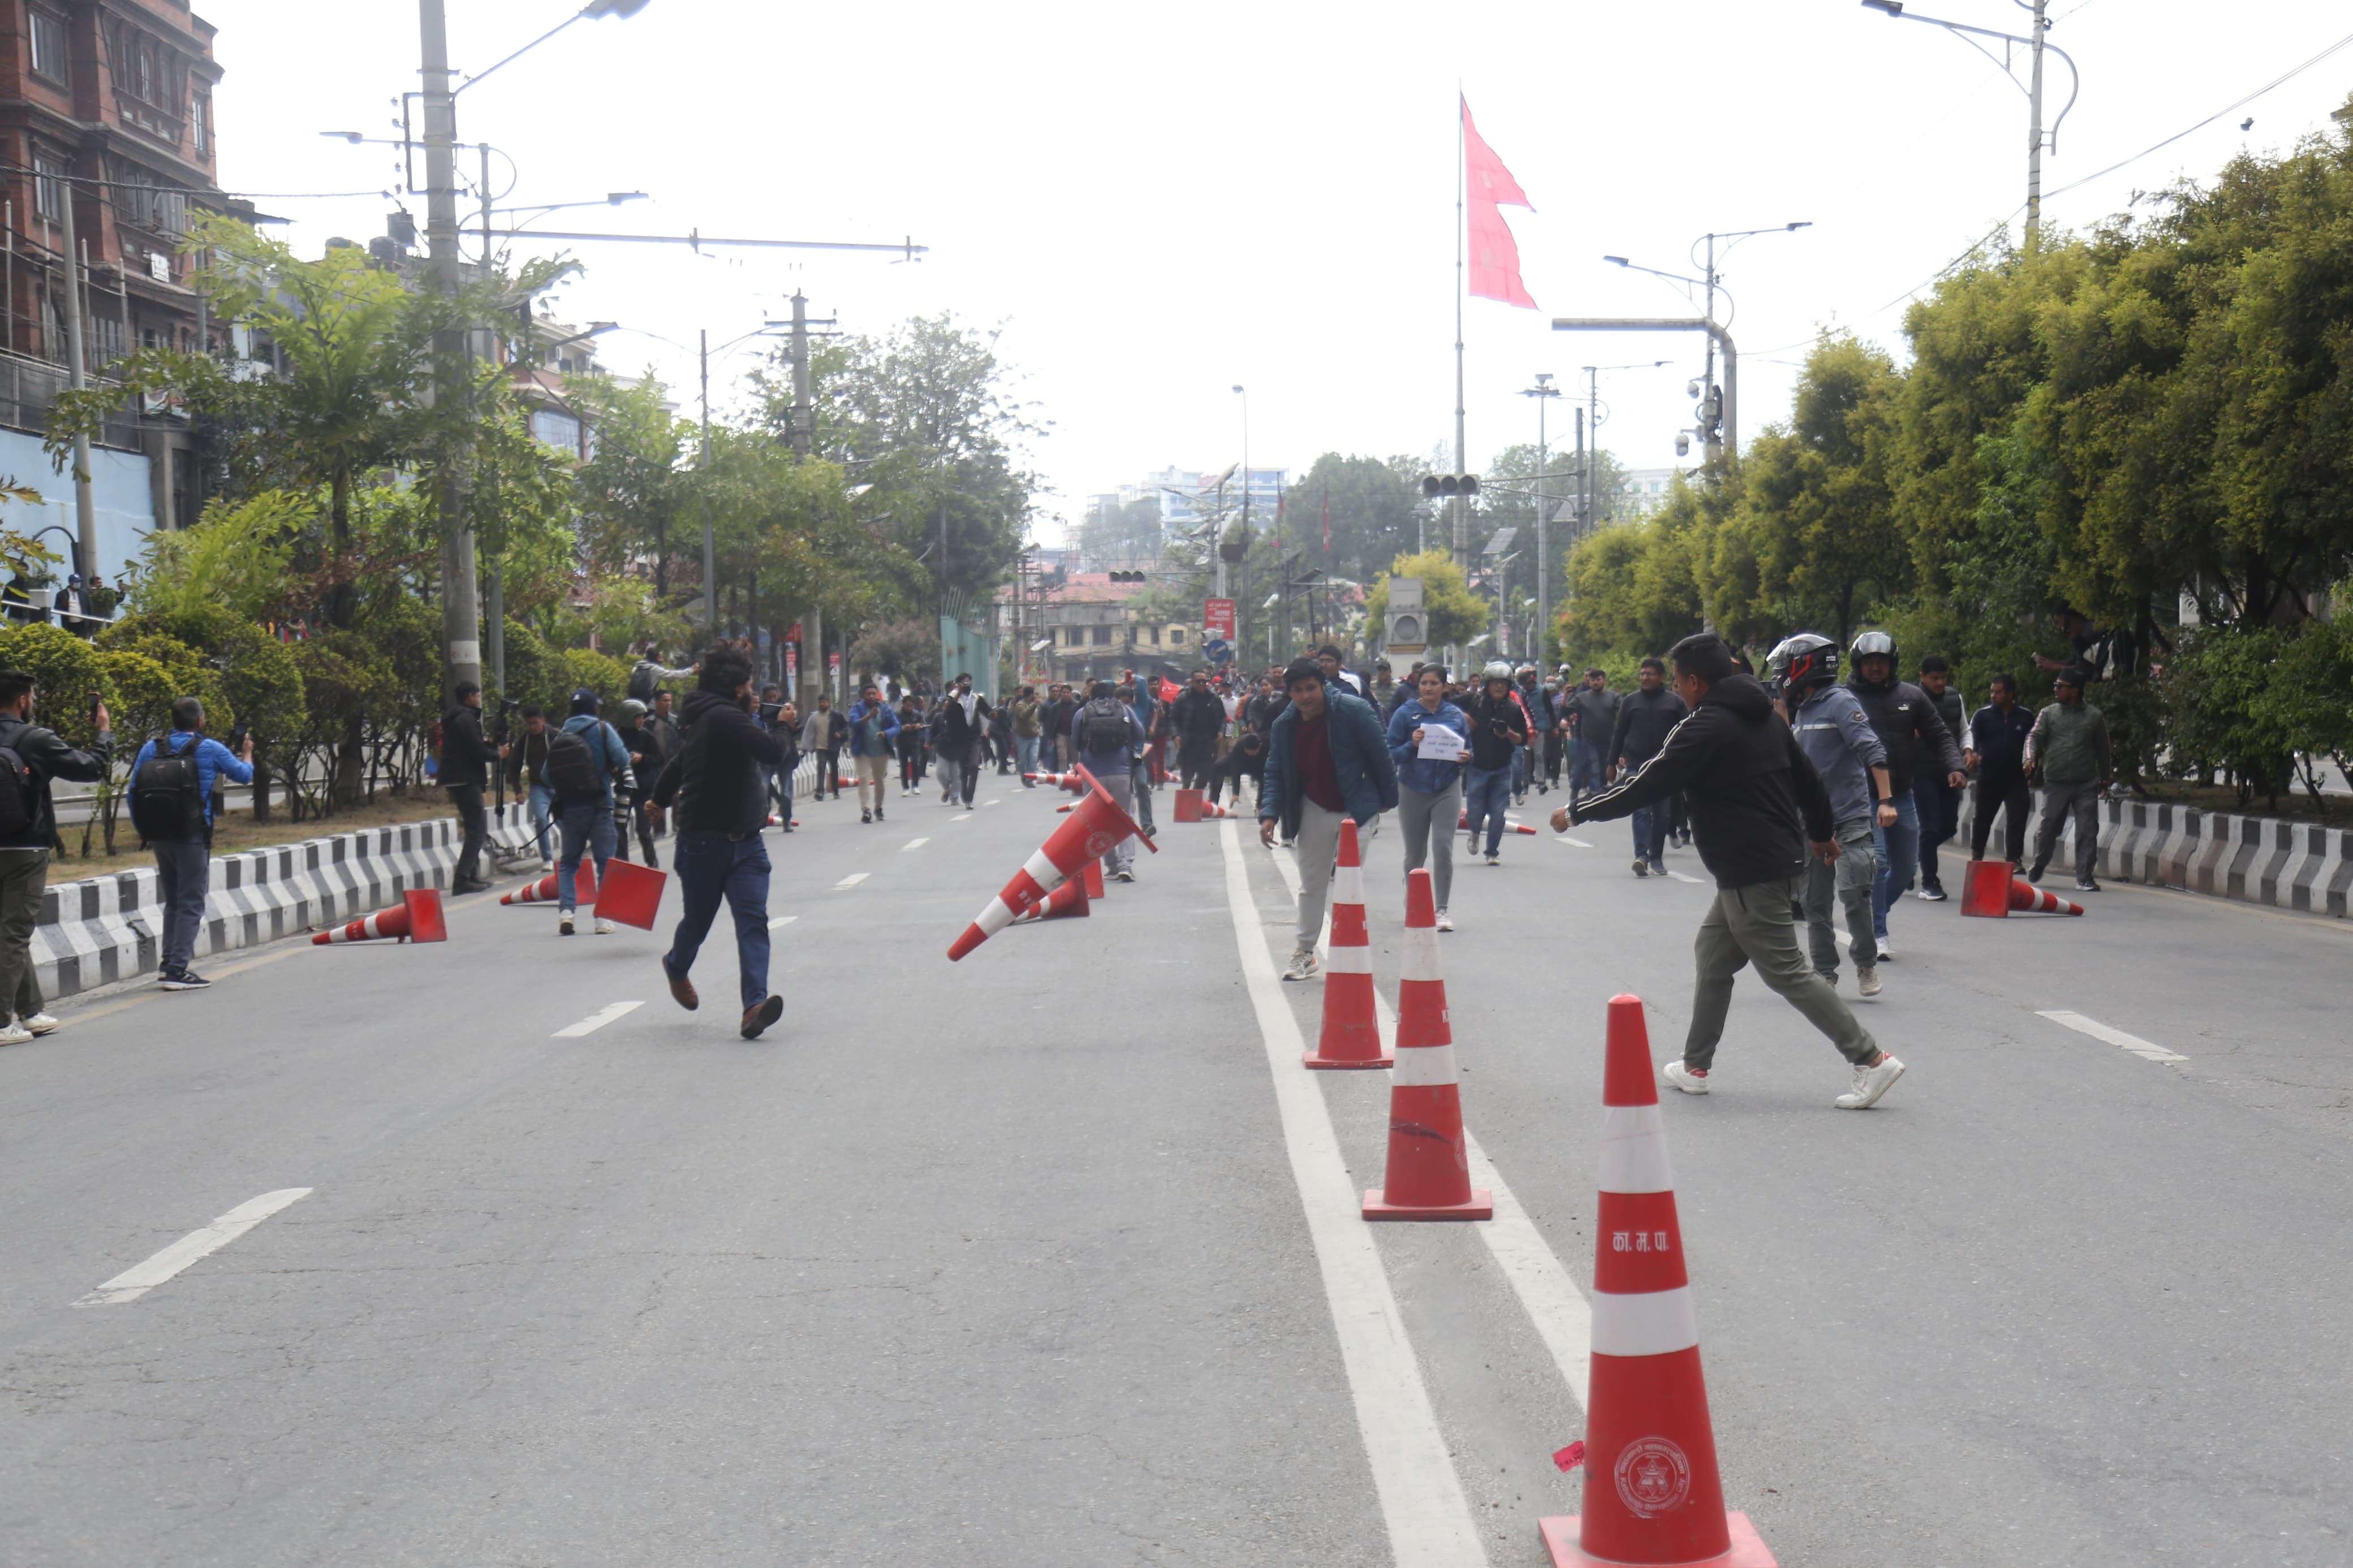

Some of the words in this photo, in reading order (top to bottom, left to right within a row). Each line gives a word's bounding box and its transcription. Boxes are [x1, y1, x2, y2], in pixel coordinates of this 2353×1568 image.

[1613, 1232, 1632, 1252] का.
[1636, 1232, 1650, 1252] म.
[1654, 1232, 1669, 1252] पा.
[1675, 1478, 1686, 1494] City
